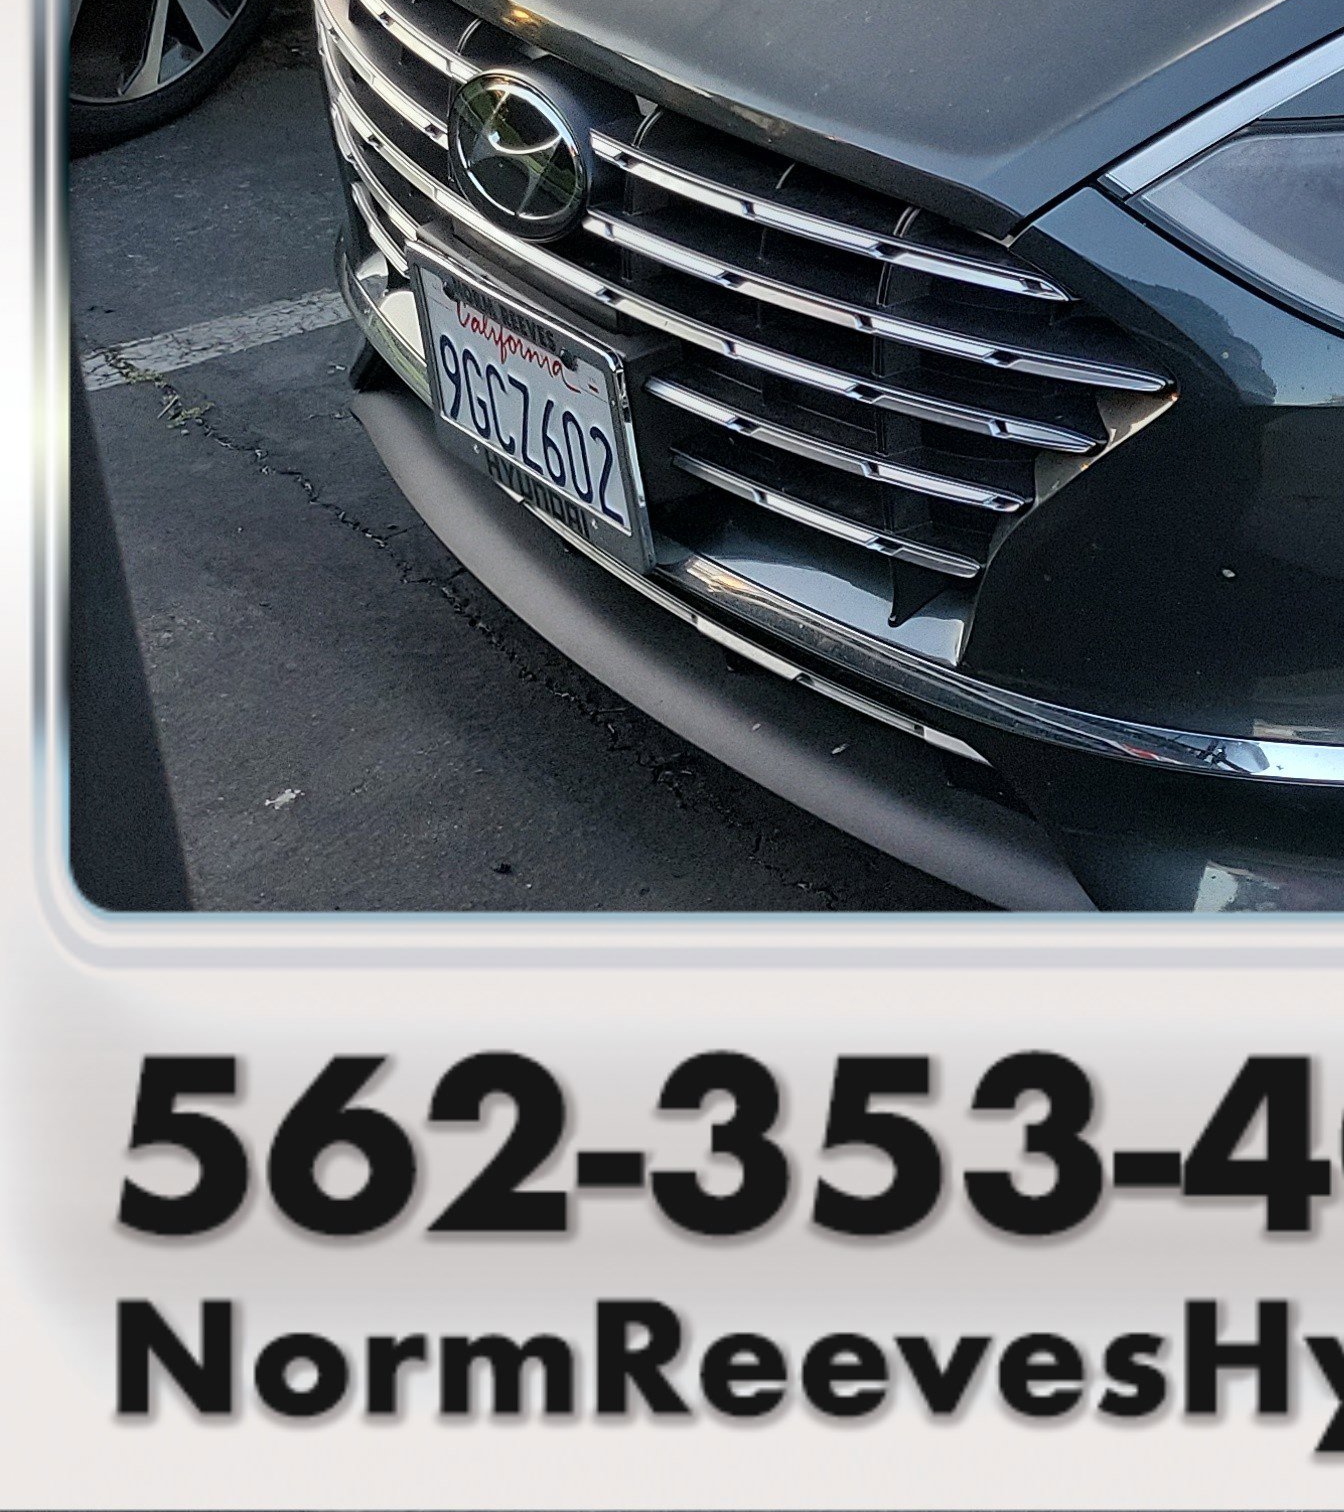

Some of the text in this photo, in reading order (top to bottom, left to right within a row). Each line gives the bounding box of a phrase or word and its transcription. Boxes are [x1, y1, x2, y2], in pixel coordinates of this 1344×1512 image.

[456, 301, 581, 393] California
[439, 334, 624, 525] 9GCZ602
[484, 448, 590, 540] HYUNDAI
